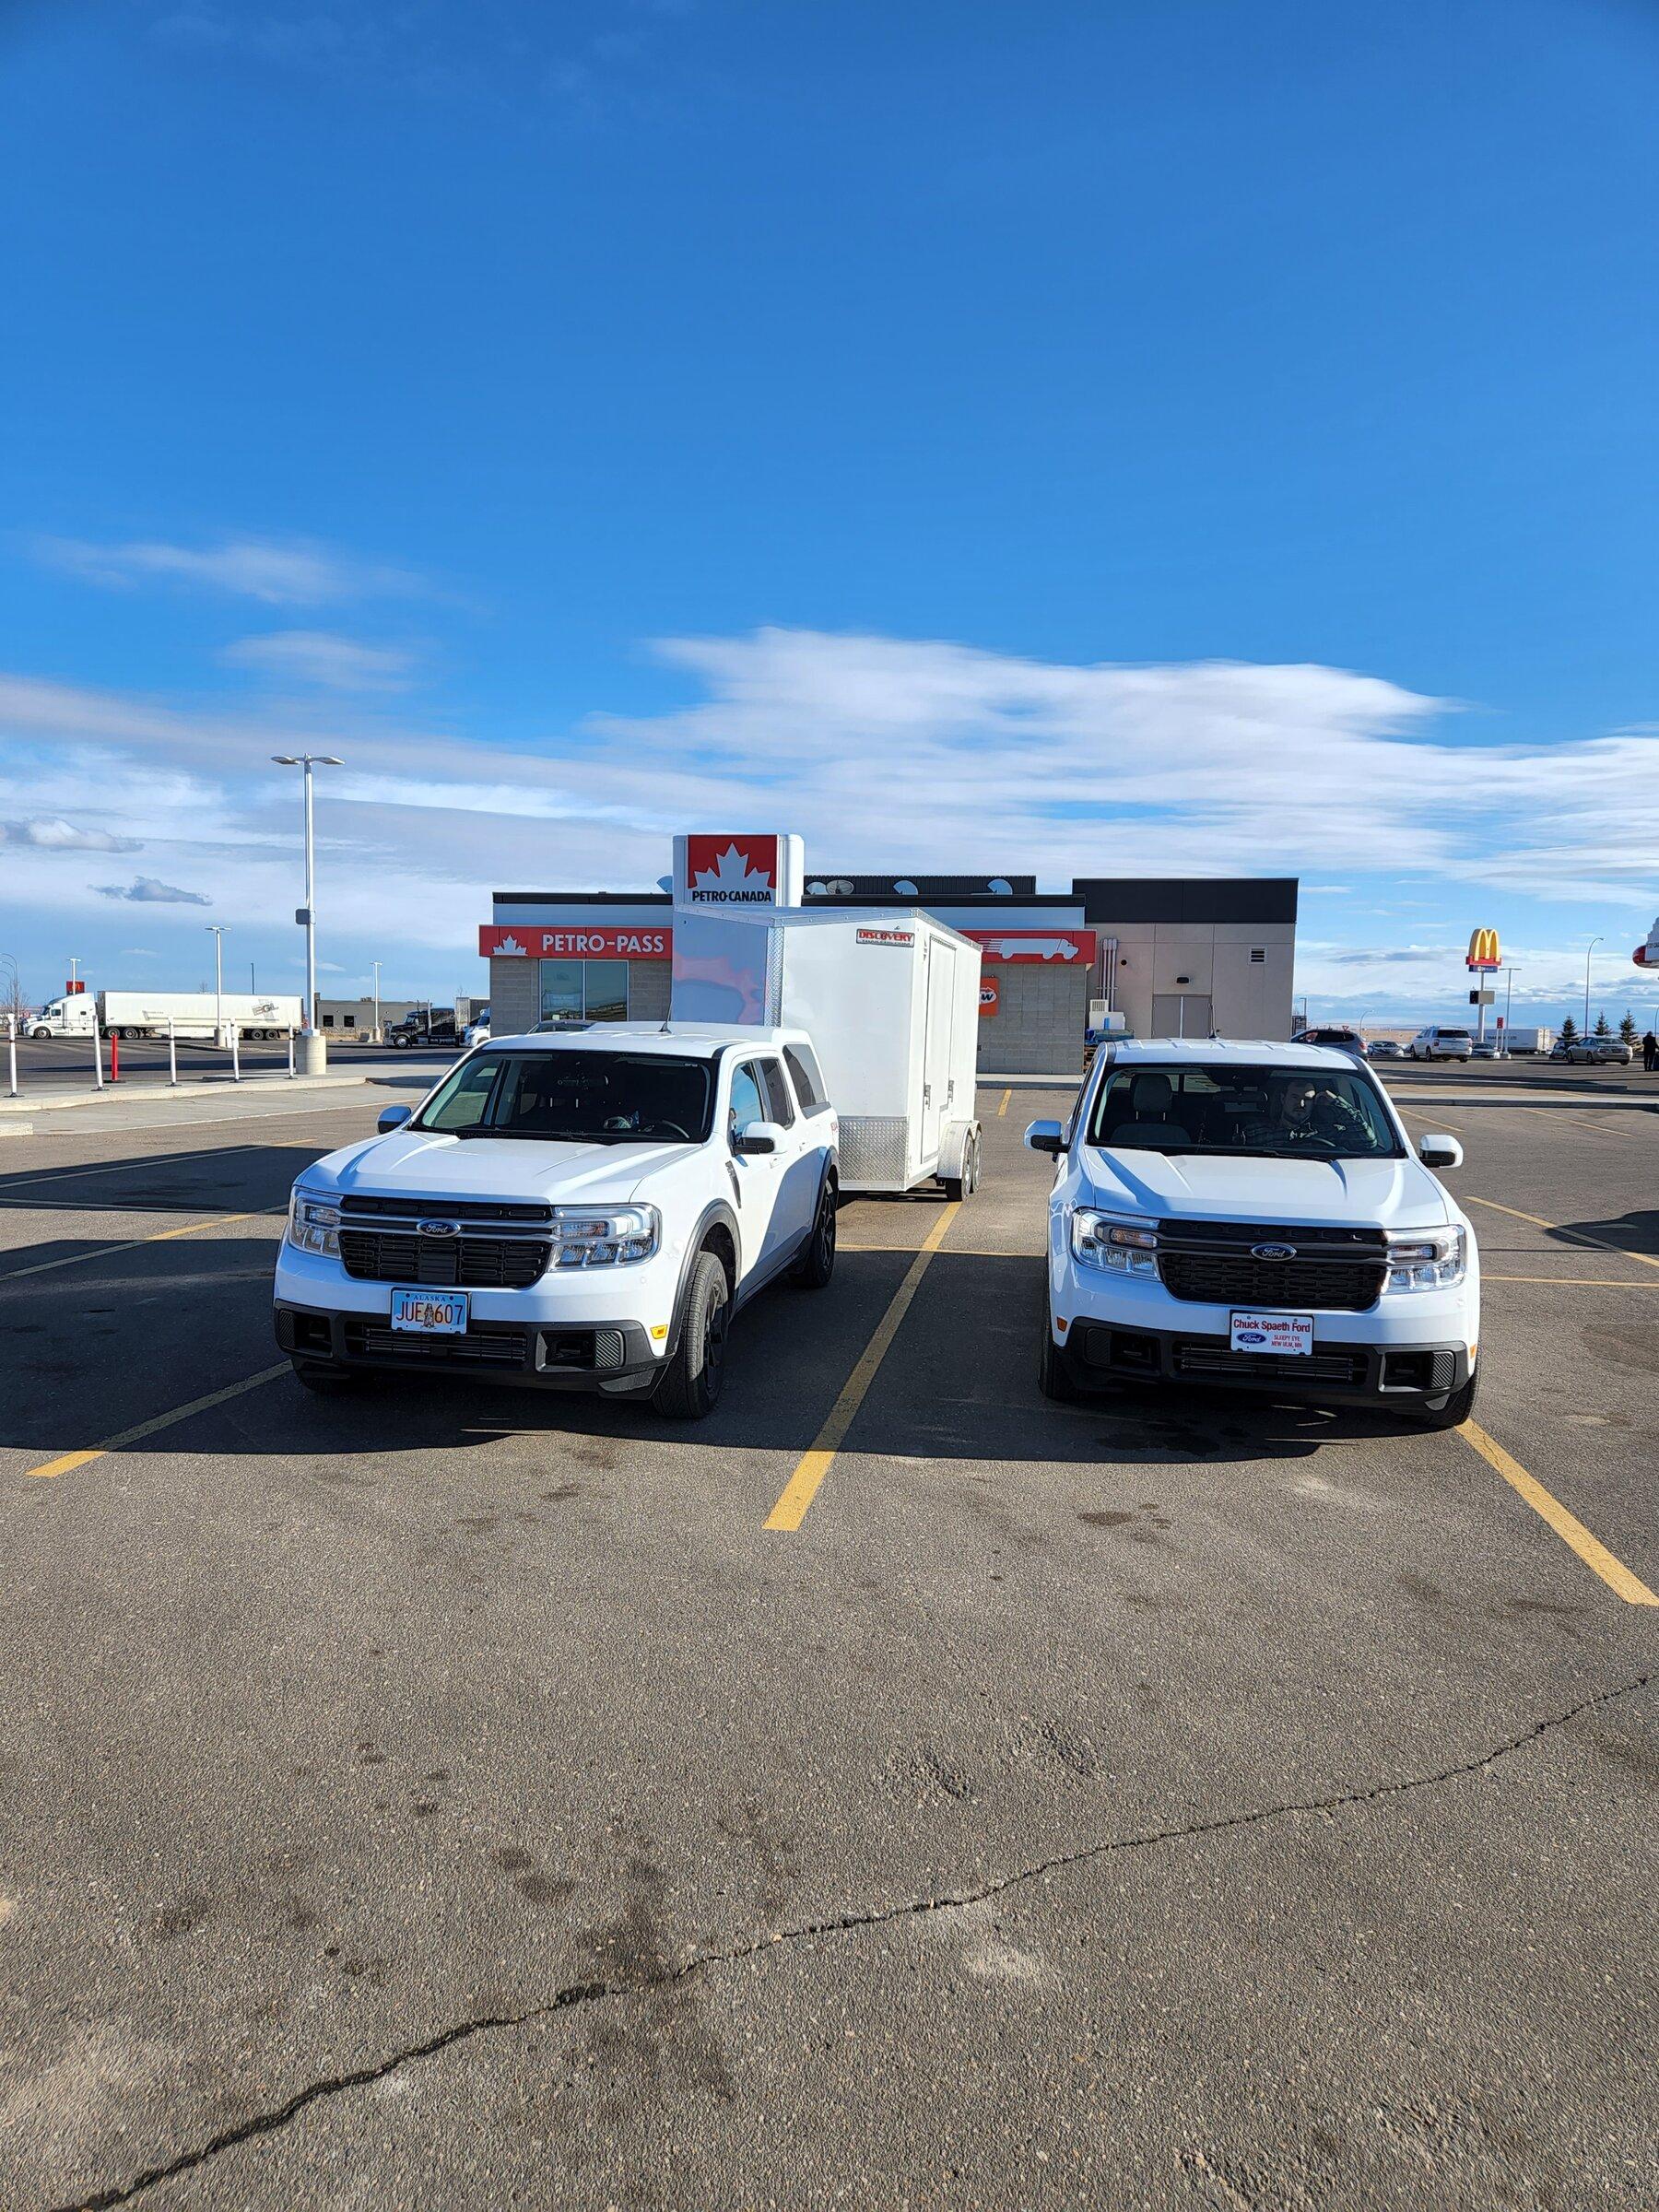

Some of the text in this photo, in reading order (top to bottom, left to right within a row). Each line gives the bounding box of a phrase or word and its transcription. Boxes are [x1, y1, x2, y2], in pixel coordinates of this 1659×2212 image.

[542, 934, 664, 953] PETRO-PASS
[413, 1294, 446, 1302] ALASKA
[395, 1300, 464, 1325] JUE 607
[1233, 1319, 1311, 1333] Chuck Spaeth Ford
[1242, 1334, 1261, 1343] Ford
